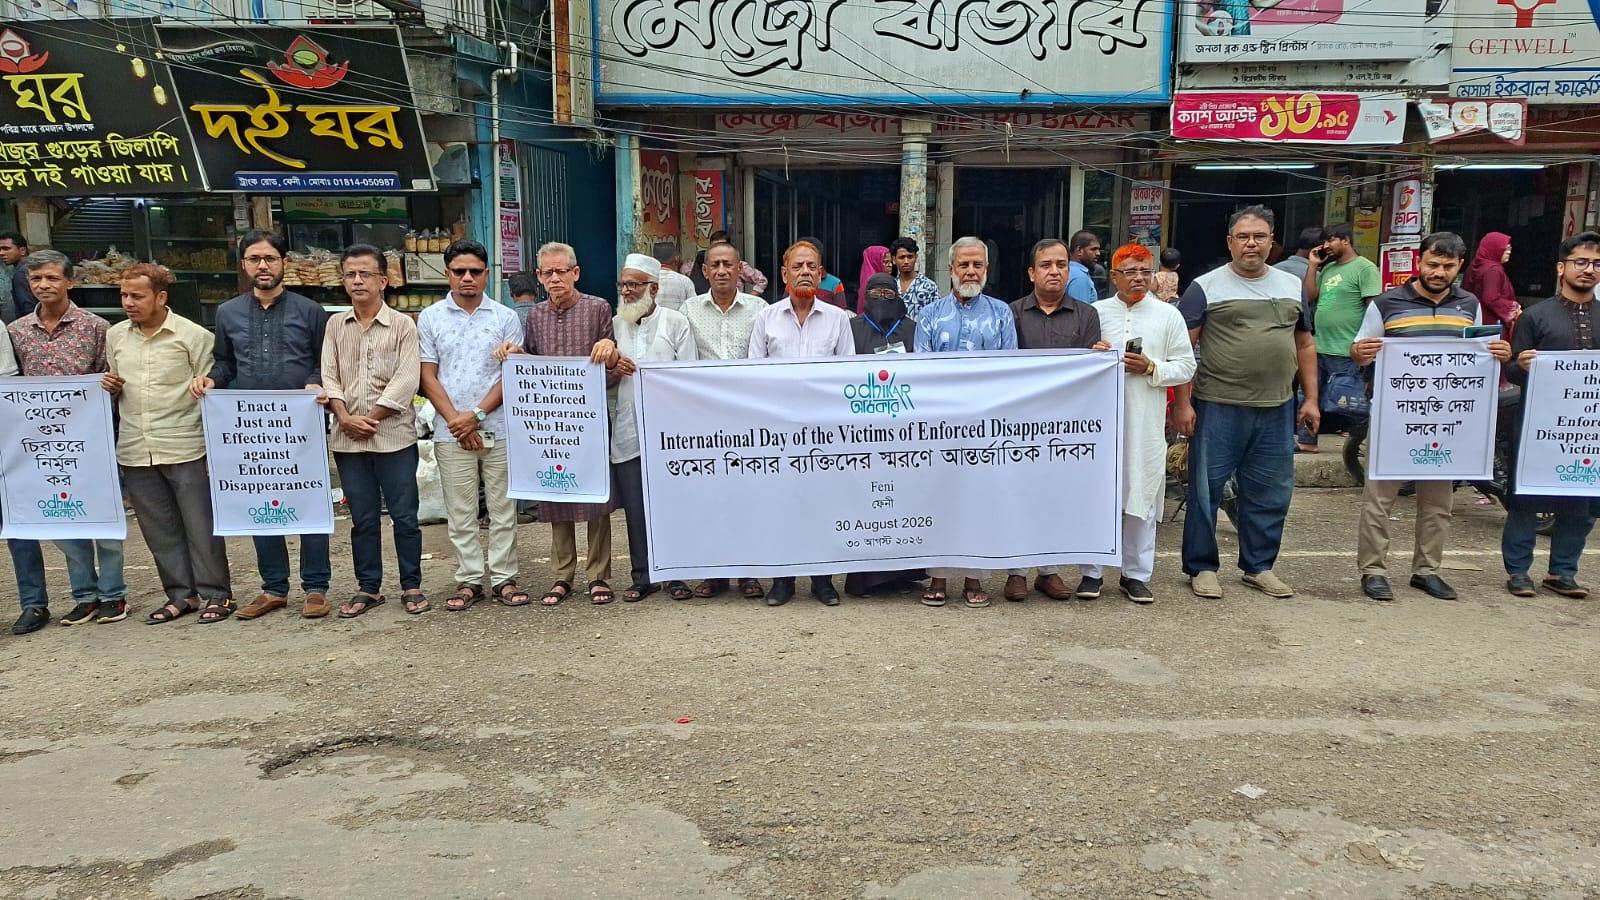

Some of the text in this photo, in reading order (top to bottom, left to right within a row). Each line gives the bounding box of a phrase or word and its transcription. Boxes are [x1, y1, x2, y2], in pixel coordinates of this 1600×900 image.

[873, 0, 1147, 61] বাজার
[1195, 43, 1222, 53] জনতা
[1468, 39, 1574, 55] GETWELL
[1456, 84, 1491, 97] মেসার্স
[1495, 75, 1550, 97] ইকবাল
[2, 73, 91, 123] ঘর
[189, 68, 404, 169] দই ঘর
[937, 111, 1136, 131] METRO BAZAR
[1178, 106, 1256, 123] ক্যাশ আউট
[45, 140, 102, 163] গুড়ের
[106, 132, 180, 159] জিলাপি
[31, 162, 68, 188] দই
[70, 162, 131, 185] পাওয়া
[333, 178, 395, 186] 01814-050987
[1403, 352, 1477, 367] “গুমের সাথে
[1554, 359, 1600, 371] Rehab
[515, 364, 586, 377] Rehabilitate
[518, 379, 584, 391] the Victims
[1389, 372, 1486, 392] জড়িত ব্যক্তিদের
[1584, 373, 1600, 385] th
[1, 388, 88, 404] বাংলাদেশ
[518, 392, 586, 405] of Enforced
[25, 406, 72, 420] থেকে
[237, 400, 287, 412] Enact a
[512, 406, 597, 420] Disappearance
[1396, 396, 1475, 416] দায়মুক্তি দেয়া
[1584, 402, 1599, 413] of
[38, 423, 66, 436] গুম
[235, 417, 292, 429] Just and
[523, 420, 584, 433] Who Have
[1405, 420, 1462, 436] চলবে না”
[222, 432, 308, 444] Effective law
[528, 434, 580, 446] Surfaced
[660, 417, 1102, 452] International Day of the Victims of Enforced Disappearances
[1536, 429, 1600, 444] Disappea
[20, 437, 86, 453] চিরতরে
[243, 448, 290, 463] against
[541, 448, 570, 460] Alive
[665, 438, 1097, 477] গুমের শিকার ব্যক্তিদের স্মরণে আন্তর্জাতিক দিবস
[34, 453, 78, 473] নির্মূল
[239, 464, 299, 476] Enforced
[44, 474, 72, 486] কর
[219, 479, 323, 494] Disappearances
[871, 480, 894, 492] Feni
[871, 496, 894, 510] ফেনী
[835, 516, 933, 533] 30 August 2026
[846, 535, 923, 548] ৩০ আগস্ট ২০২৬
